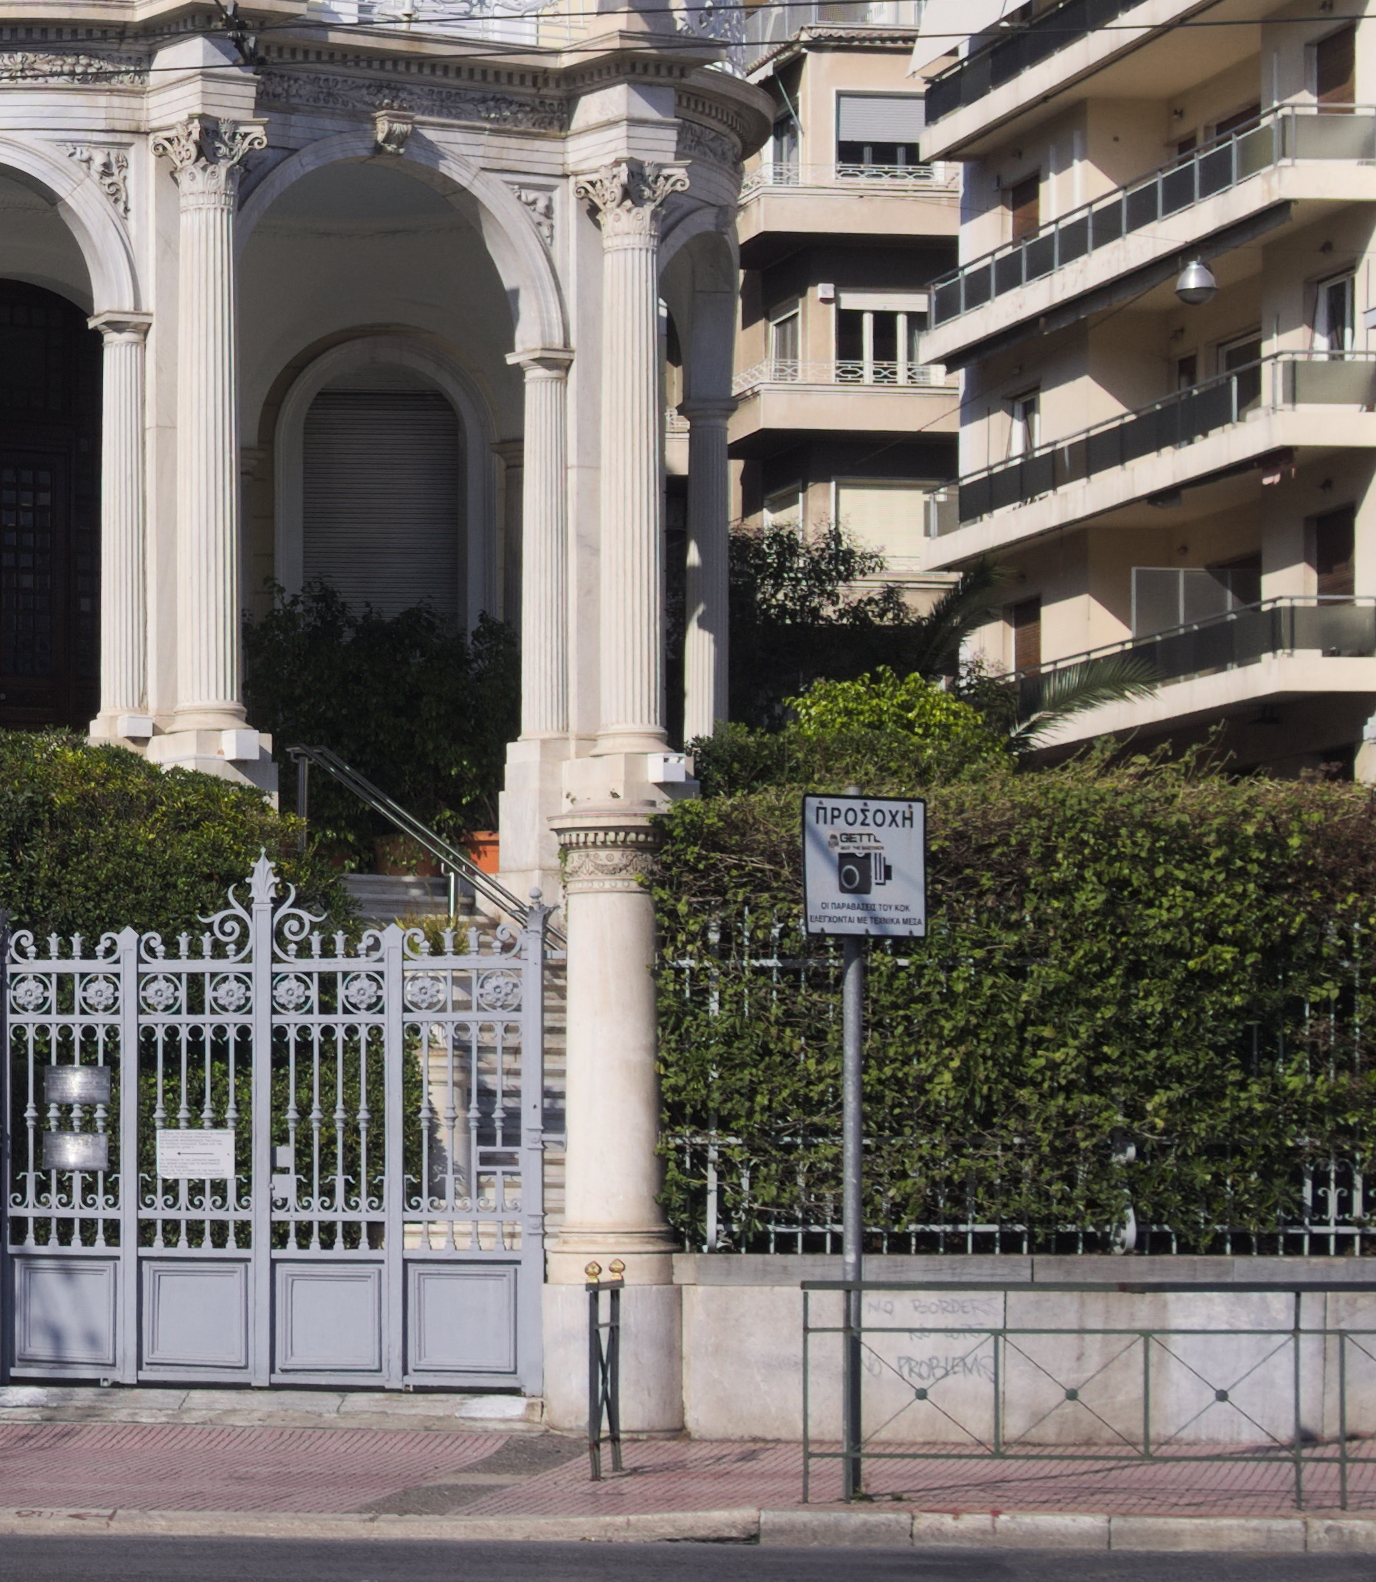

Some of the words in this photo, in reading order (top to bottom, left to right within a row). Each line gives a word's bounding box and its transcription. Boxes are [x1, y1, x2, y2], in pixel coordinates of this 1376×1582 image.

[816, 806, 913, 828] ΠΡΟΣΟΧΗ
[878, 904, 893, 912] ΤΟΥ
[895, 904, 910, 912] ΚΟΚ
[857, 916, 868, 924] ΜΕ
[902, 918, 922, 926] ΜΕΣΑ
[868, 1298, 894, 1315] NO
[911, 1297, 999, 1316] BORDERS
[897, 1353, 995, 1384] PROBLEMS
